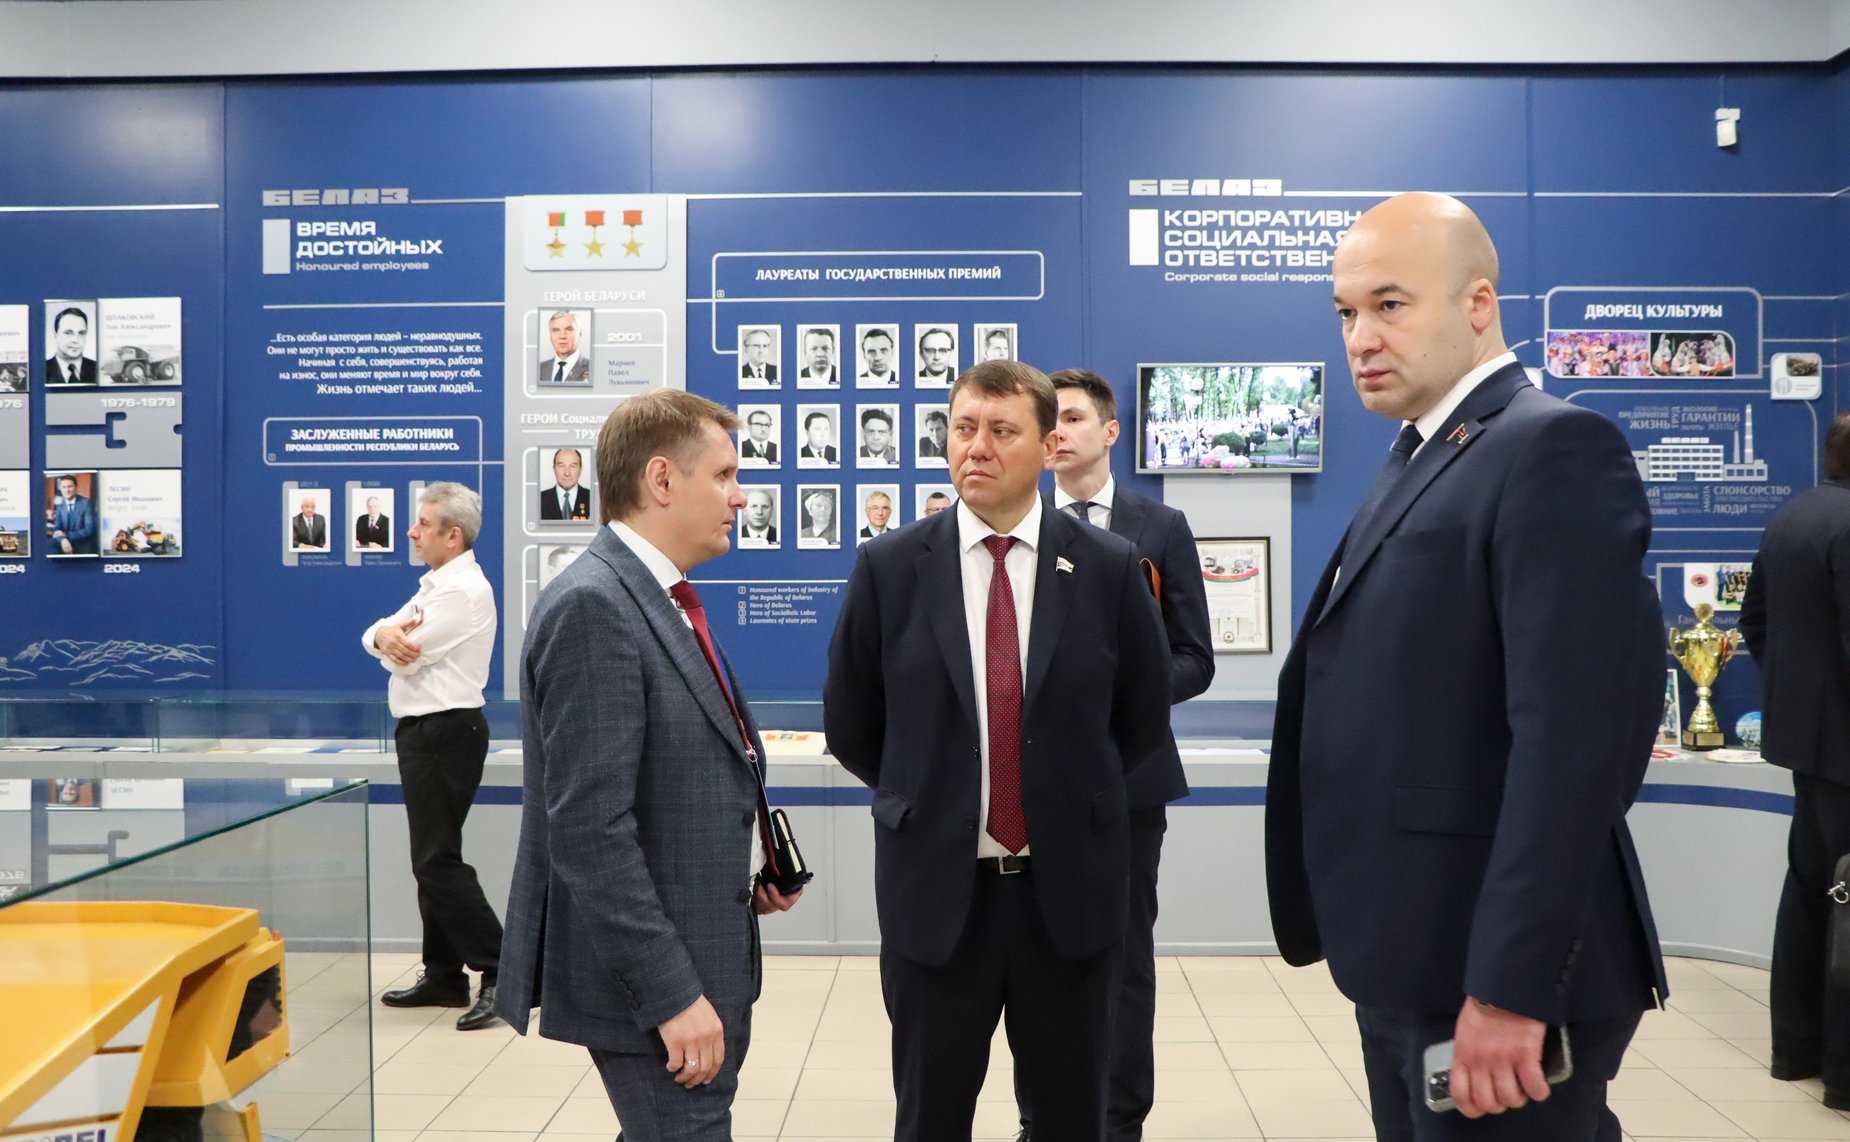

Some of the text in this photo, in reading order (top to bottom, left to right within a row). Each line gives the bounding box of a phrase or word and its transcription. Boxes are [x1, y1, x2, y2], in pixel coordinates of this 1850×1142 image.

[1164, 210, 1361, 227] КОРПОРАТИВН
[296, 221, 377, 236] ВРЕМЯ
[296, 237, 444, 258] ДОСТОЙНЫХ
[1164, 250, 1335, 267] ОТВЕТСТВЕН
[296, 261, 429, 272] Honoured employees
[755, 265, 1002, 281] ЛАУРЕАТЫ ГОСУДАРСТВЕННЫХ ПРЕМИЙ
[1164, 272, 1238, 283] Corporate
[1240, 272, 1279, 281] social
[544, 289, 647, 301] ГЕРОЙ БЕЛАРУСИ
[1584, 304, 1723, 320] ДВОРЕЦ КУЛЬТУРЫ
[297, 333, 328, 342] особая
[329, 334, 372, 344] категория
[373, 332, 401, 343] людей
[410, 332, 483, 343] неравнодушных.
[607, 332, 642, 342] 2001
[267, 346, 285, 355] Они
[299, 347, 324, 356] могут
[325, 346, 356, 356] просто
[357, 346, 379, 354] жить
[388, 345, 448, 356] существовать
[449, 344, 465, 353] как
[298, 358, 336, 367] Начиная
[447, 356, 483, 367] работая
[279, 372, 290, 380] на
[320, 371, 338, 379] они
[339, 371, 372, 379] меняют
[373, 371, 401, 381] время
[410, 370, 429, 380] мир
[429, 370, 459, 380] вокруг
[460, 368, 483, 378] себя.
[317, 384, 353, 395] Жизнь
[354, 384, 405, 394] отмечает
[406, 383, 437, 393] таких
[101, 398, 175, 407] 1976-1979
[520, 412, 609, 425] ГЕРОИ Социали
[1681, 412, 1740, 422] ГАРАНТИИ
[1629, 420, 1671, 429] ЖИЗНЬ
[290, 428, 454, 440] ЗАСЛУЖЕННЫЕ РАБОТНИКИ
[285, 442, 460, 452] ПРОМЫШЛЕННОСТИ РЕСПУБЛИКИ БЕЛАРУСЬ
[1713, 485, 1792, 495] СПОНСОРСТВО
[1712, 504, 1748, 514] ЛЮДИ
[0, 564, 26, 573] 024
[104, 564, 140, 573] 2024
